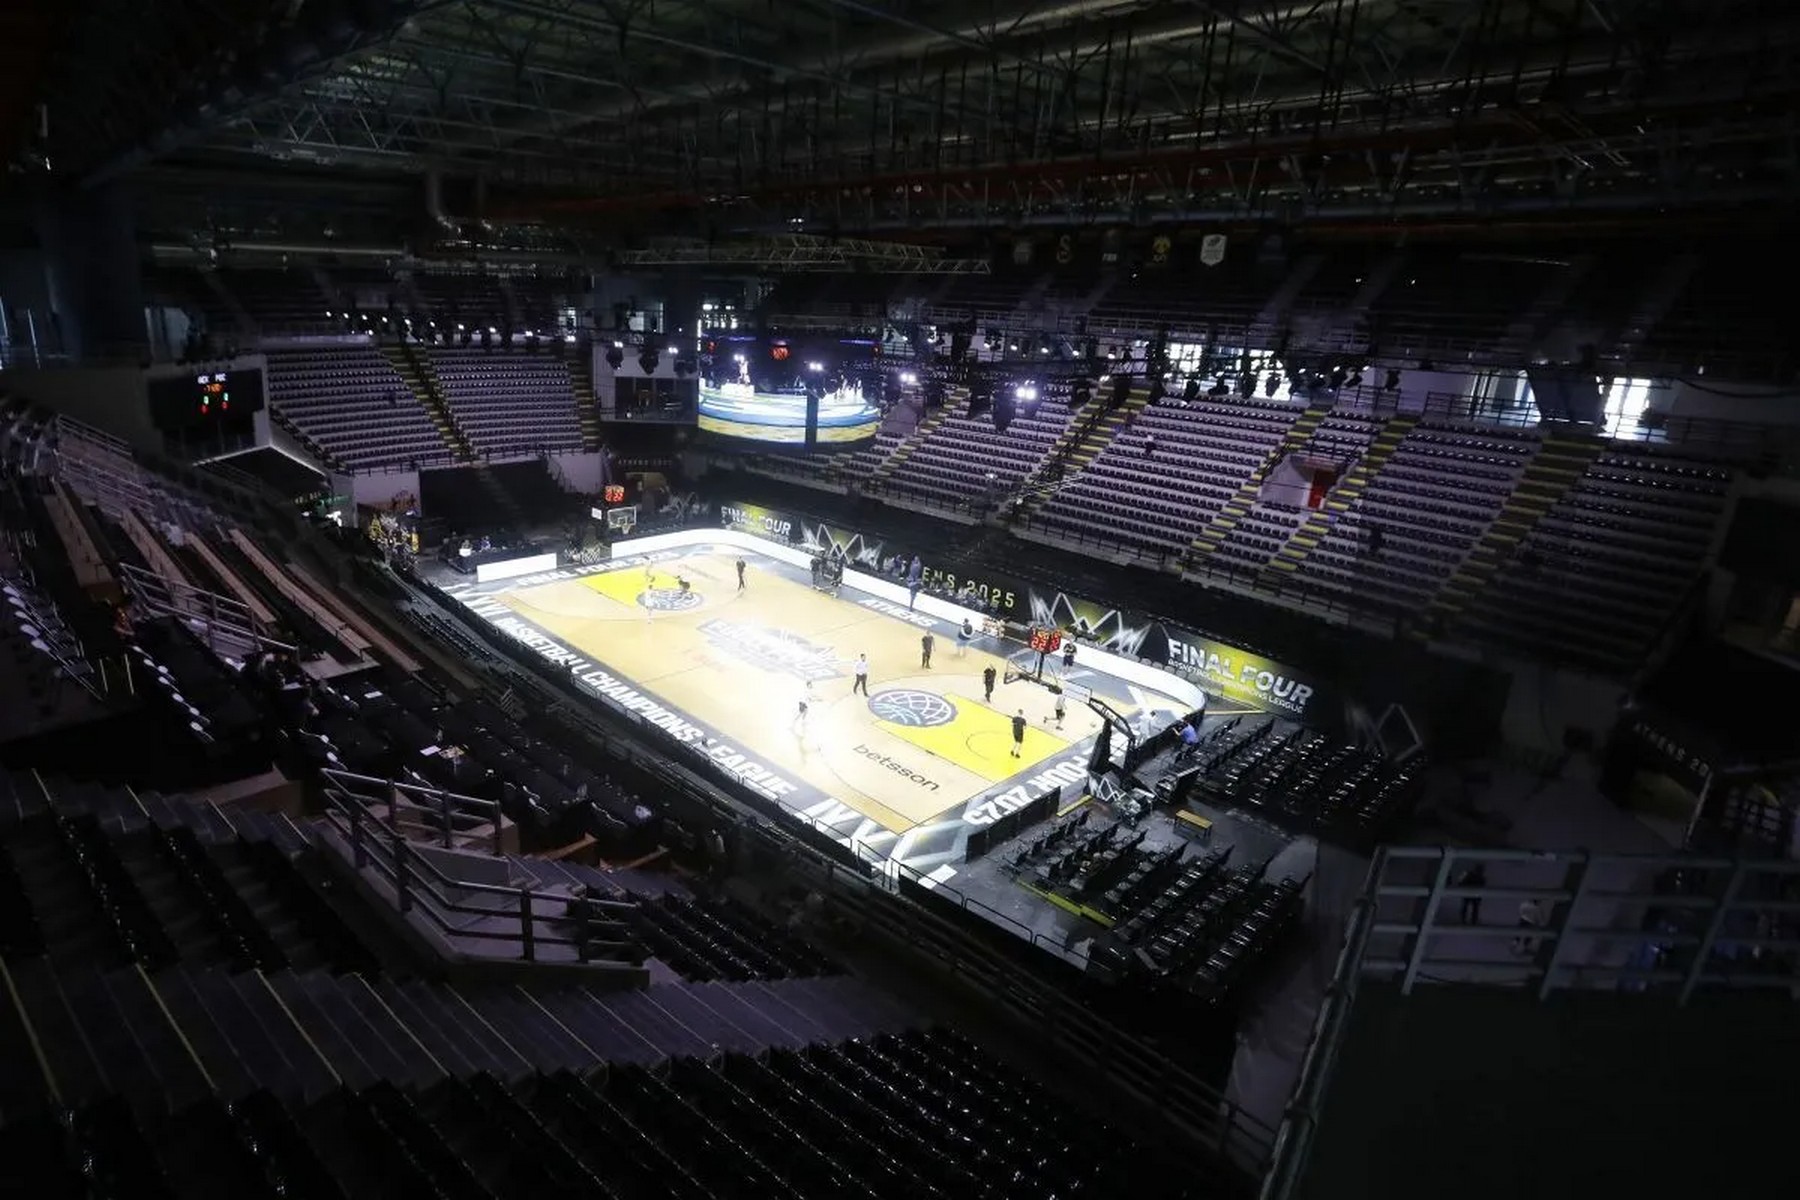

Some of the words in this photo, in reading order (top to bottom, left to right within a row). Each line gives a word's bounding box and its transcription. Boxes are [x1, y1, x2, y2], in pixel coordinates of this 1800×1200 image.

[757, 515, 791, 536] FOUR
[966, 580, 1015, 609] 2025
[1168, 638, 1235, 680] FINAL
[1240, 665, 1313, 706] FOUR
[496, 617, 591, 675] BASKETBALL
[581, 671, 704, 743] CHAMPIONS
[690, 737, 799, 797] LEAGUE
[1268, 695, 1304, 714] LEAGUE
[852, 743, 941, 792] betsson
